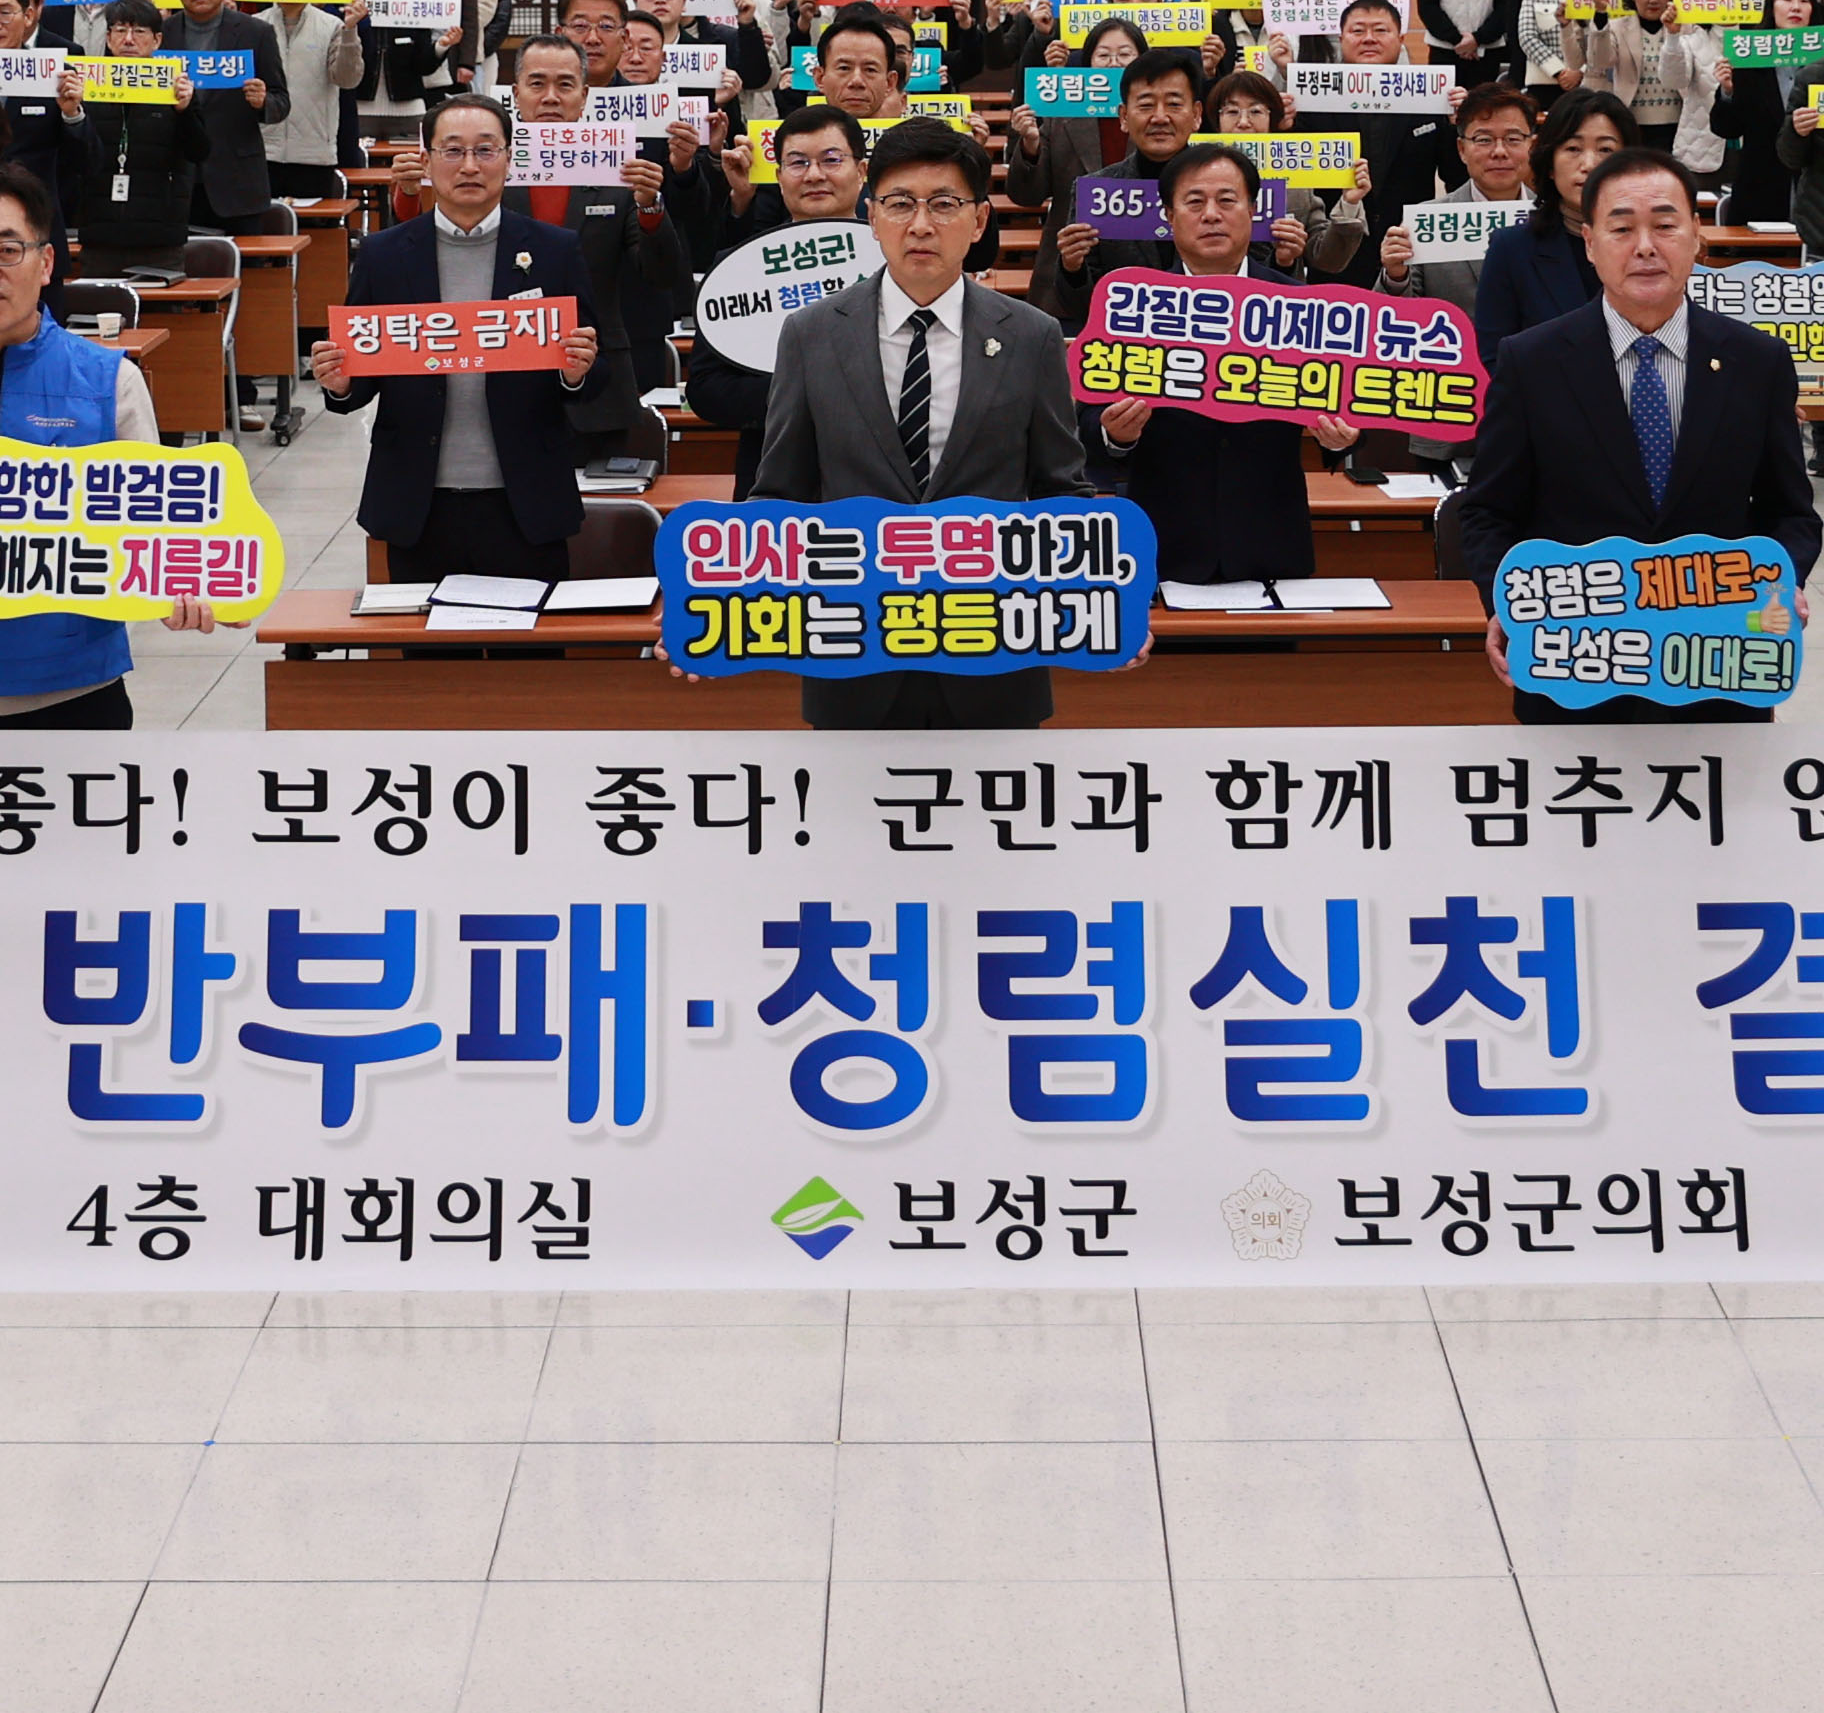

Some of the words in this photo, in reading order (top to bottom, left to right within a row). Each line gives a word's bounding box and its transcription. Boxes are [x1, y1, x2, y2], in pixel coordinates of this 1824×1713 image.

[1732, 33, 1795, 58] 청렴한
[1036, 73, 1111, 103] 청렴은
[1295, 71, 1344, 98] 부정부패
[1347, 73, 1376, 97] OUT,
[1379, 72, 1427, 99] 긍정사회
[1430, 74, 1448, 96] UP
[539, 127, 626, 147] 단호하게!
[539, 148, 626, 169] 당당하게!
[761, 231, 857, 277] 보성군!
[346, 312, 460, 355] 청탁은
[471, 307, 562, 350] 금지!
[704, 292, 773, 323] 이래서
[1106, 282, 1234, 345] 갑질은
[1239, 294, 1368, 358] 어제의
[1374, 306, 1463, 366] 뉴스
[1080, 340, 1207, 401] 청렴은
[1213, 352, 1341, 414] 오늘의
[1349, 364, 1476, 425] 트렌드
[83, 460, 222, 524] 발걸음!
[120, 536, 260, 599] 지름길!
[683, 517, 865, 586] 인사는
[876, 513, 1136, 586] 투명하게,
[1503, 558, 1625, 624] 청렴은
[1632, 549, 1783, 611] 제대로~
[683, 591, 866, 659] 기회는
[879, 588, 1119, 657] 평등하게
[1530, 624, 1652, 685] 보성은
[1660, 634, 1795, 694] 이대로!
[250, 761, 532, 856] 보성이
[584, 759, 813, 858] 좋다!
[871, 758, 1164, 856] 군민과
[1204, 756, 1395, 854] 함께
[1450, 752, 1726, 850] 멈추지
[65, 1173, 209, 1260] 4층
[254, 1172, 595, 1262] 대회의실
[887, 1172, 1139, 1261] 보성군
[1250, 1210, 1282, 1230] 의회
[1333, 1165, 1753, 1256] 보성군의회
